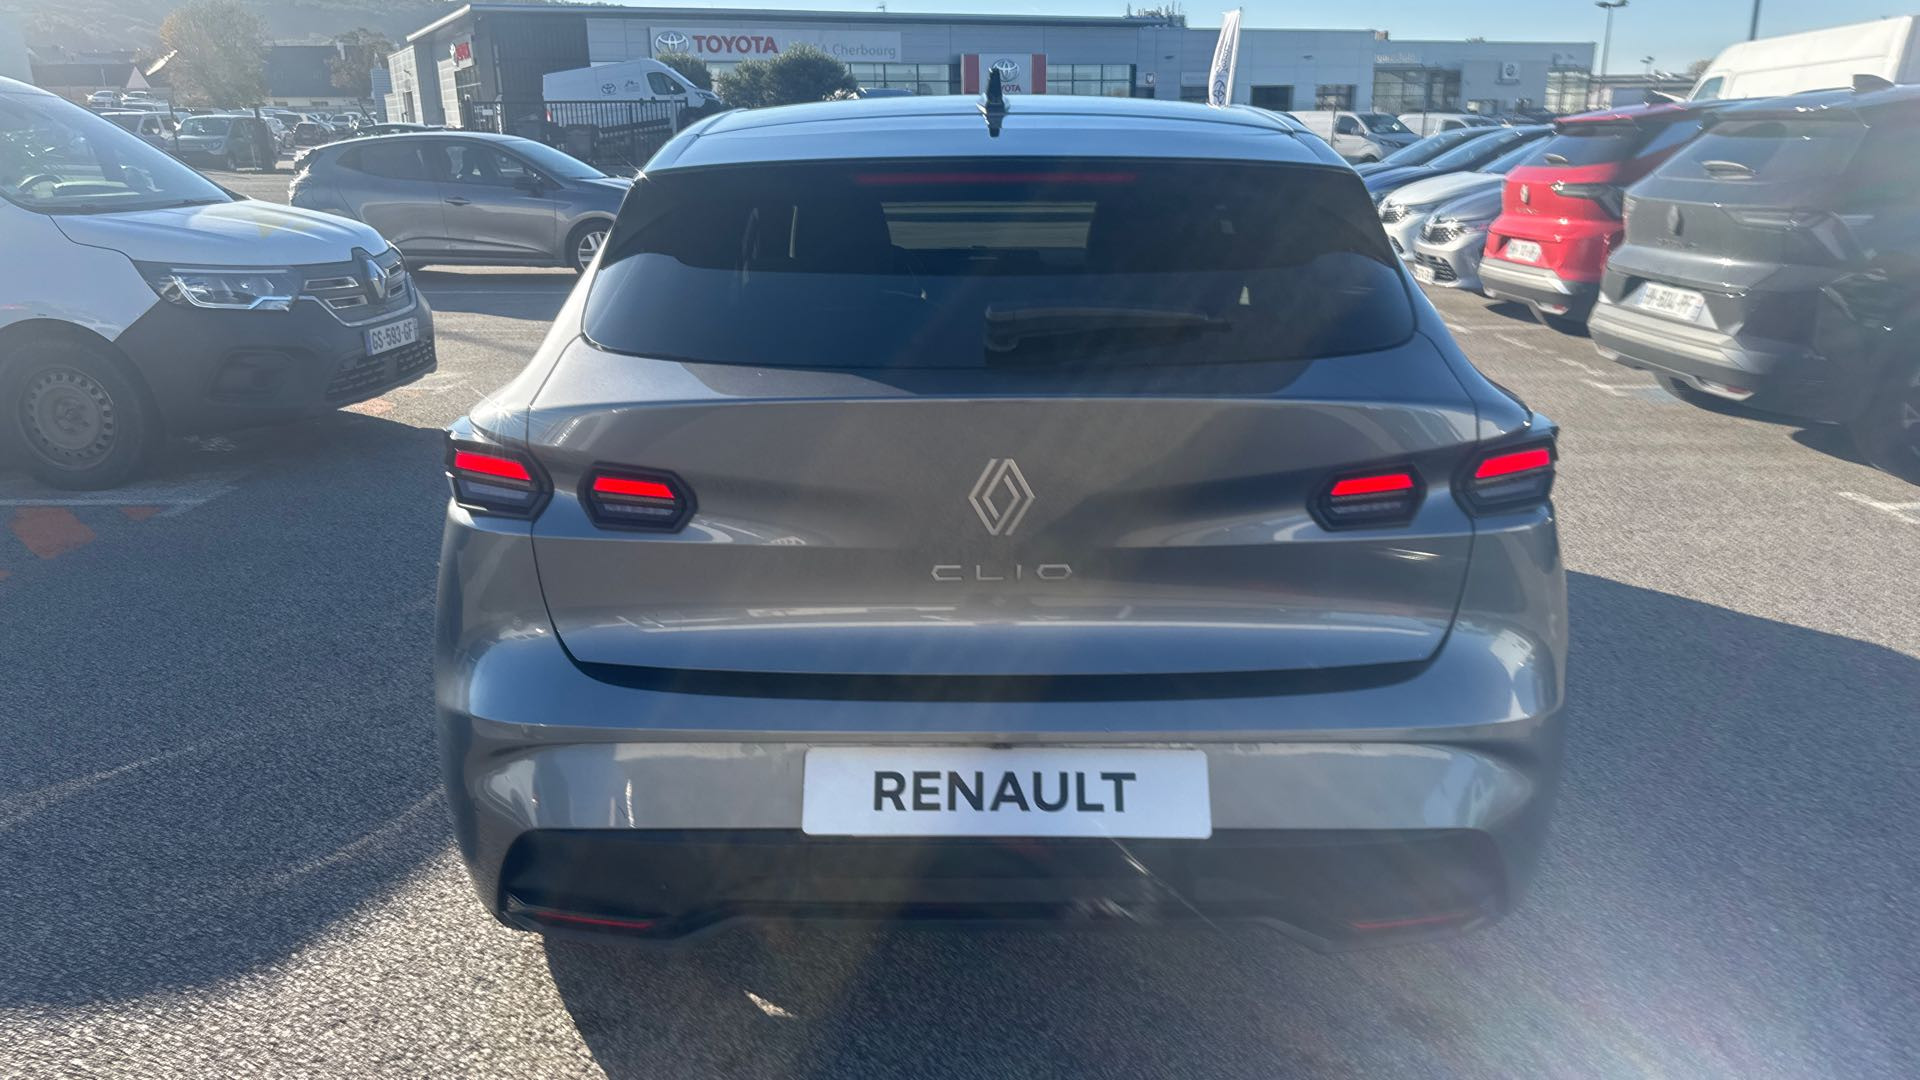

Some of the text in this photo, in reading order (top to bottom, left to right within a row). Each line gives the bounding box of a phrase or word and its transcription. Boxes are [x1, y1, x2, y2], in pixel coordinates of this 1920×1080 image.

[692, 35, 779, 54] TOYOTA
[831, 43, 896, 59] Cherbourg
[372, 320, 413, 350] GS-593-GF
[931, 564, 1073, 581] CLIO
[873, 770, 1136, 813] RENAULT
